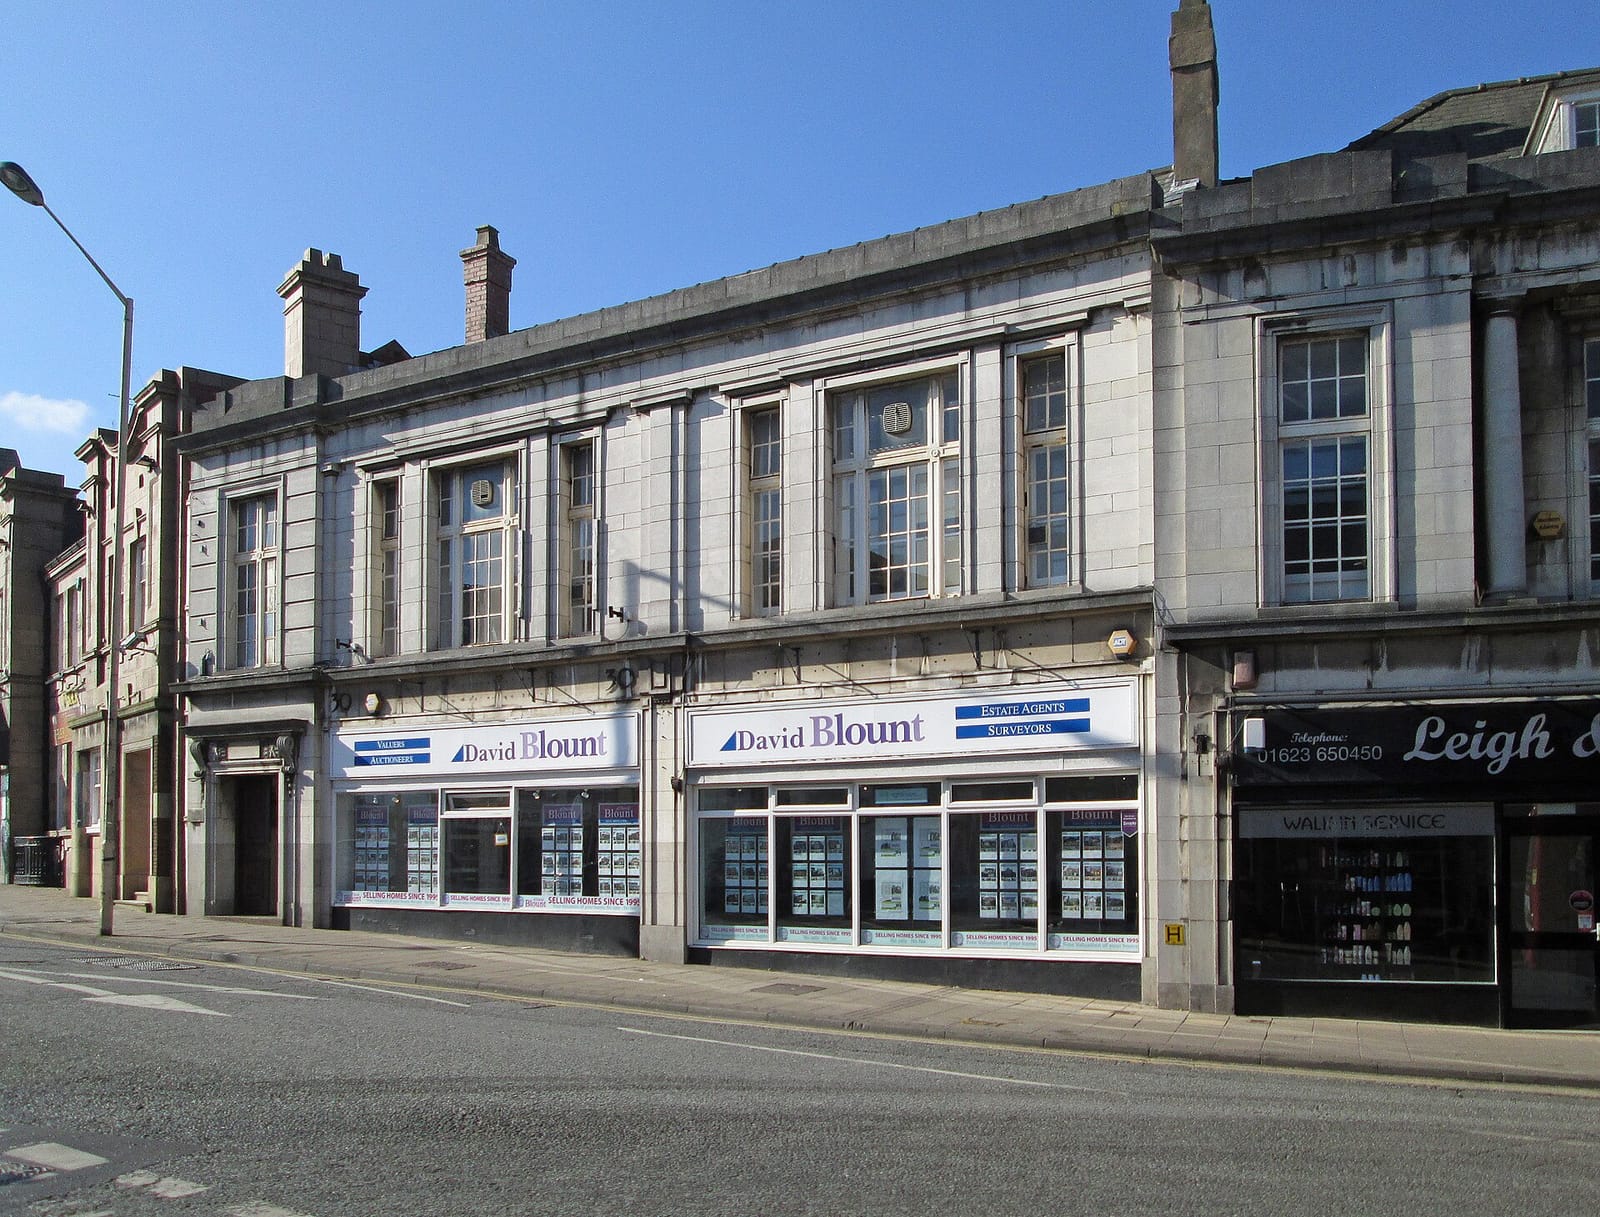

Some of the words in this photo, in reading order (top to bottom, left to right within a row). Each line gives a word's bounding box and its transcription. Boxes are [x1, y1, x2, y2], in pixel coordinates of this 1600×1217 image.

[606, 668, 635, 691] 30
[331, 693, 352, 713] 30
[981, 705, 1019, 717] ESTATE
[1022, 703, 1065, 715] AGENTS
[738, 727, 805, 751] David
[810, 713, 926, 747] Blount
[988, 724, 1052, 736] SURVEYORS
[377, 740, 405, 749] VALUERS
[1291, 732, 1349, 745] Telephone:
[1403, 713, 1554, 775] Leigh
[465, 741, 516, 763] David
[520, 729, 608, 760] Blount
[1258, 748, 1311, 763] 01623
[1316, 745, 1383, 761] 650450
[370, 756, 414, 765] AUCTIONEERS
[414, 809, 438, 819] Bloun
[548, 809, 576, 819] Blount
[604, 808, 634, 818] Blount
[989, 812, 1029, 823] Blount
[1071, 810, 1113, 820] Blount
[733, 816, 766, 826] Blount
[800, 816, 834, 825] Blount
[1363, 814, 1446, 830] SERVICE
[386, 892, 407, 900] HOMES
[525, 899, 547, 908] Blount
[548, 896, 576, 904] SELLING
[577, 897, 602, 905] HOMES
[603, 897, 624, 906] SINCE
[1168, 926, 1180, 942] H
